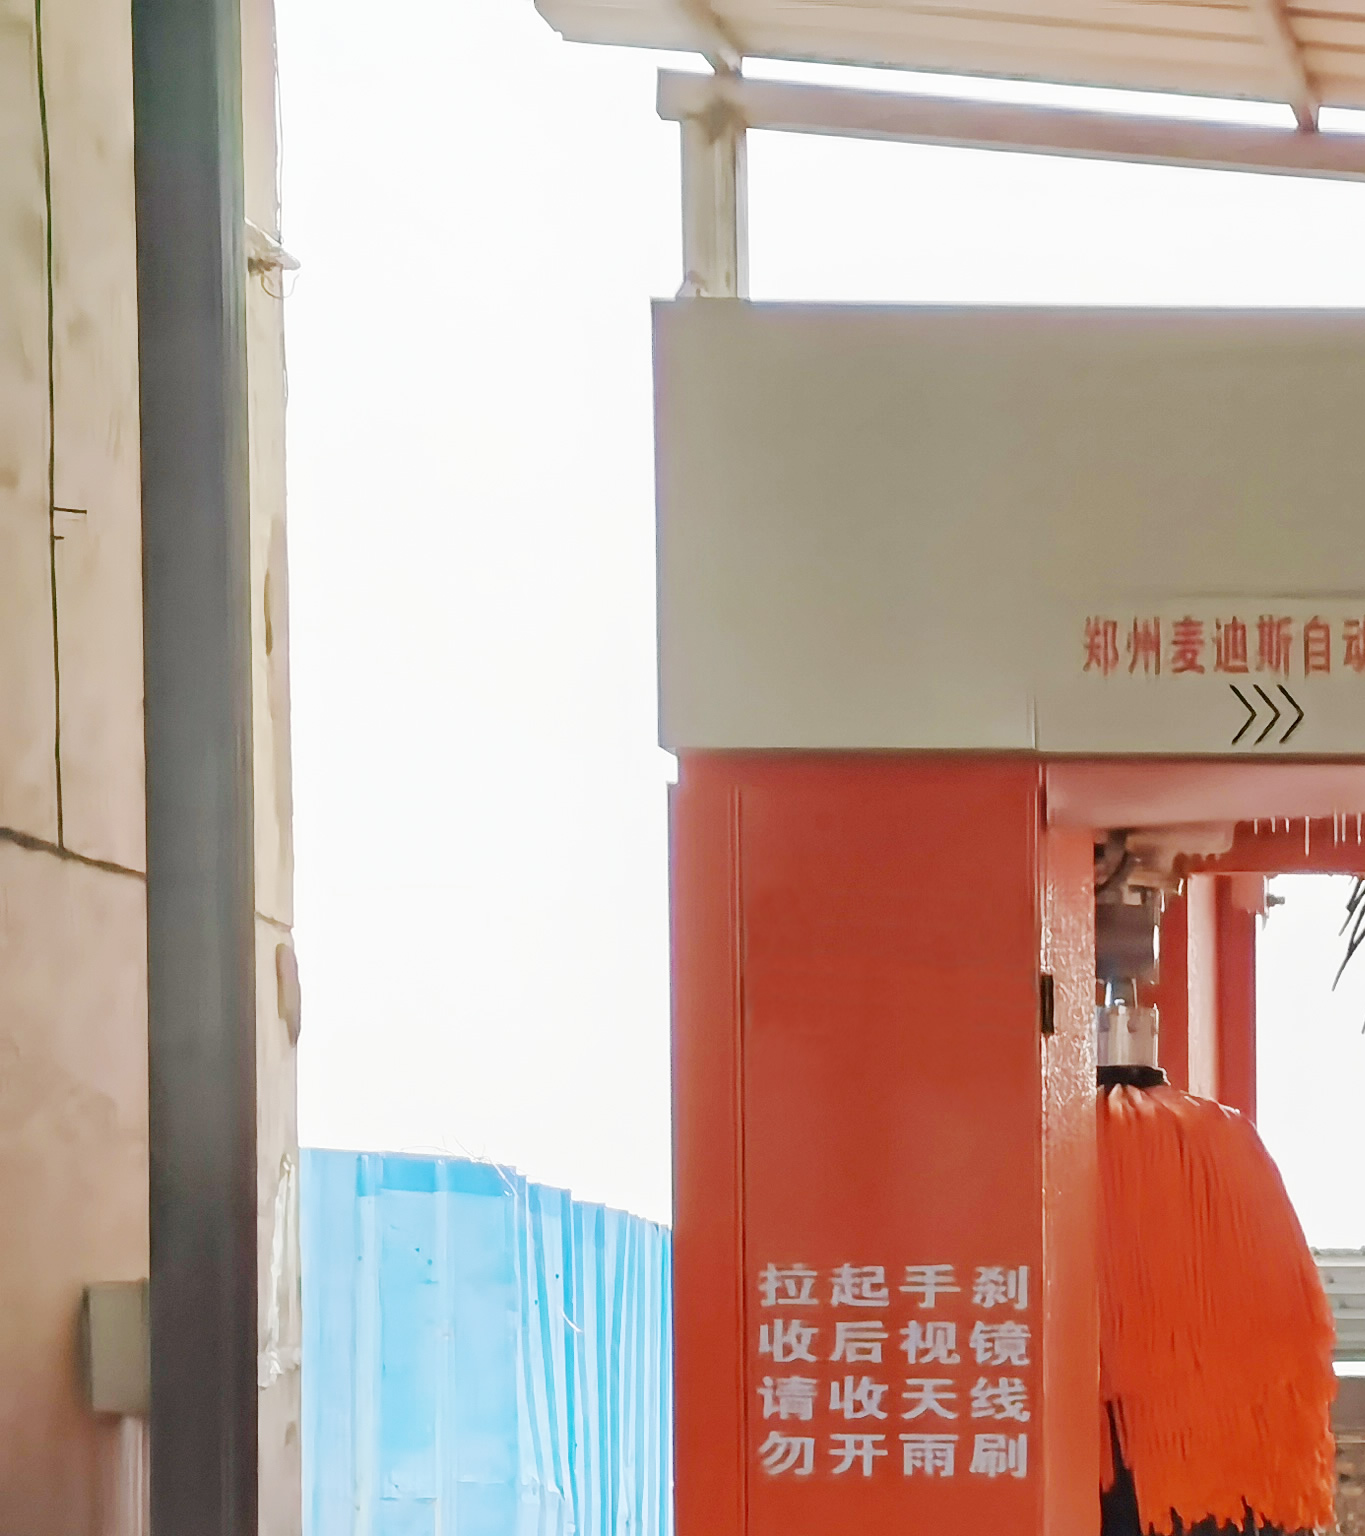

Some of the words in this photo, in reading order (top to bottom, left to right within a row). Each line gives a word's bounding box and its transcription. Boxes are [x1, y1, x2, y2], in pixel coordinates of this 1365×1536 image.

[759, 1263, 1029, 1310] 拉起手刹
[758, 1319, 1031, 1366] 收后视镜
[757, 1376, 1031, 1422] 请收天线
[759, 1431, 1028, 1478] 勿开雨刷
